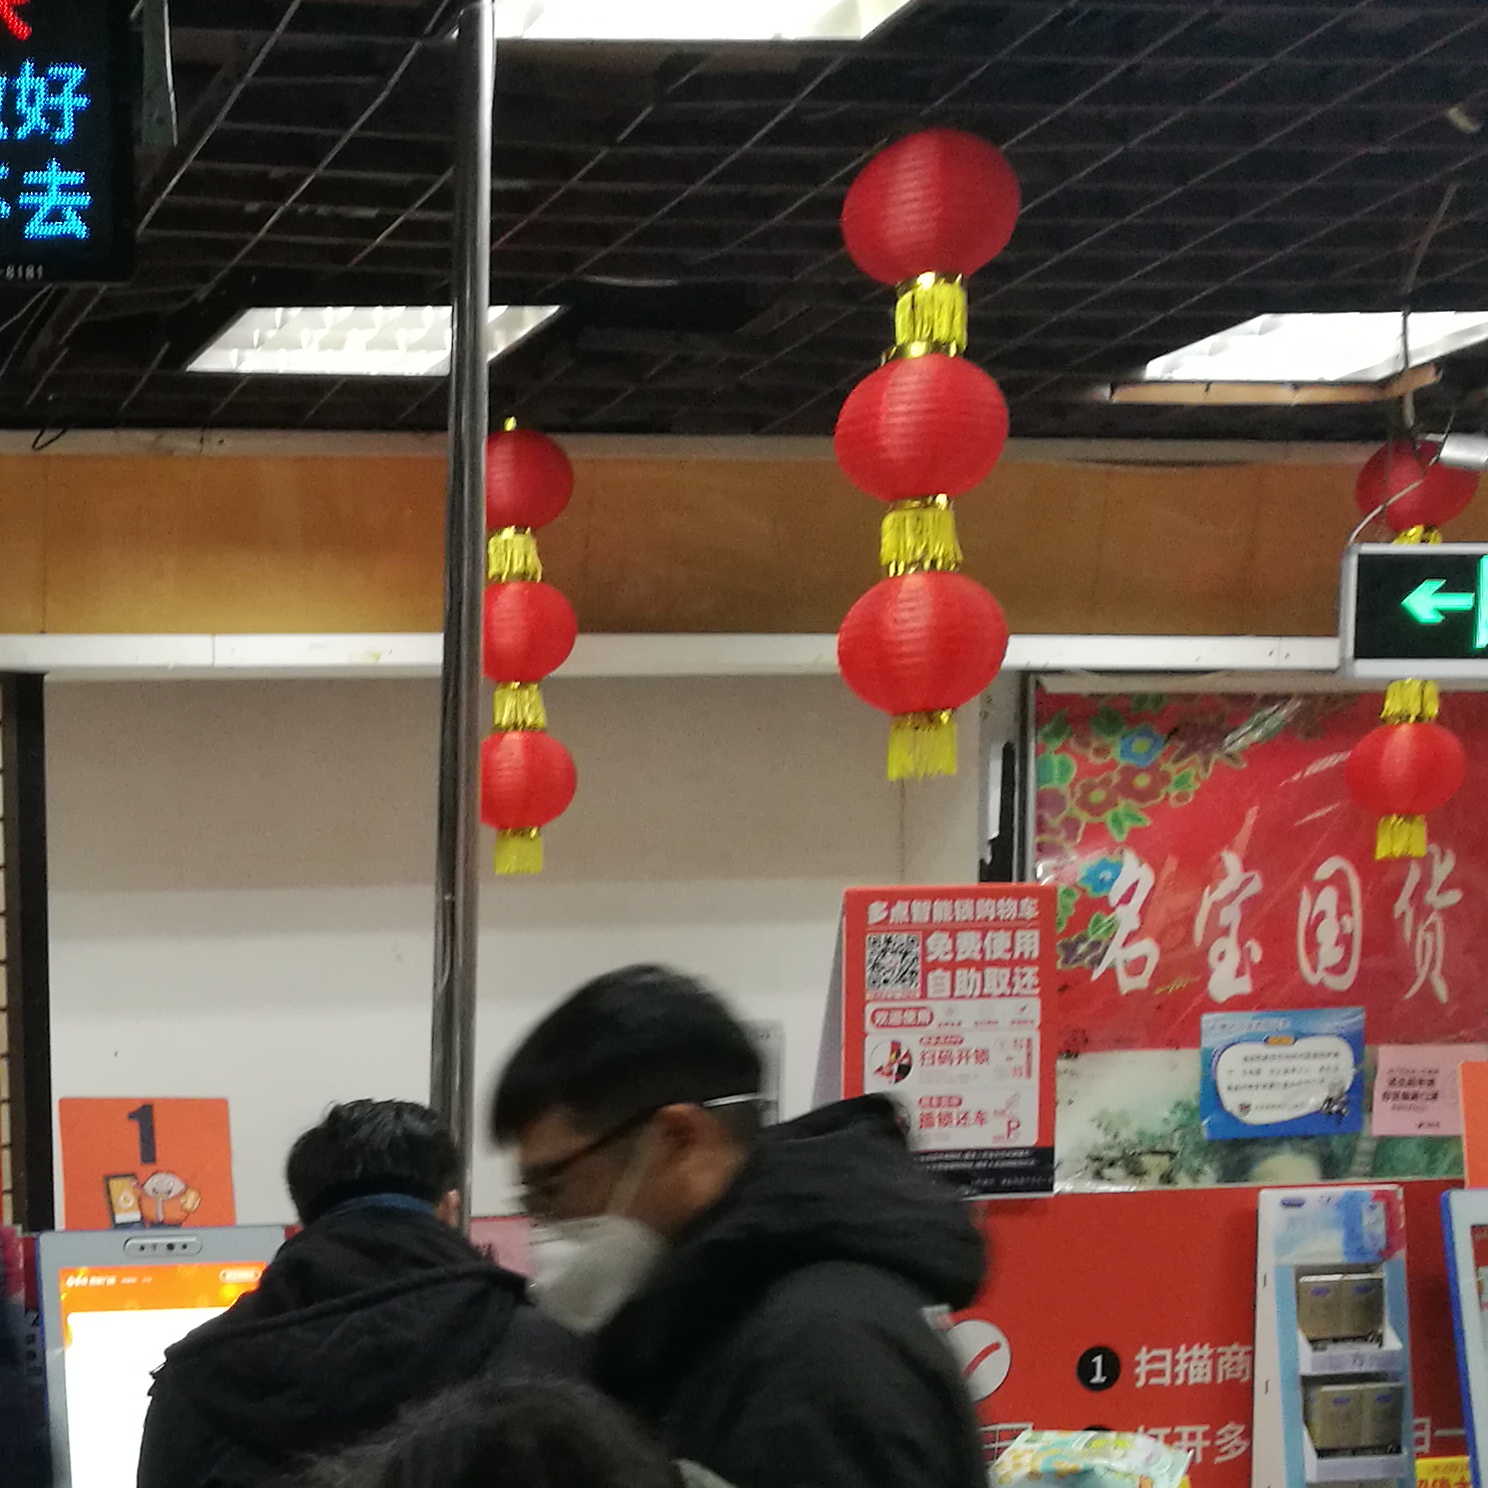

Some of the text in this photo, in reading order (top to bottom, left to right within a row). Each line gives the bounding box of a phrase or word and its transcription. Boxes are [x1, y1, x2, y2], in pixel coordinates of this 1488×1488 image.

[926, 929, 1040, 962] 免费使用
[926, 966, 1041, 998] 自助取还
[127, 1104, 157, 1164] 1
[1089, 1342, 1252, 1388] 1 扫描商
